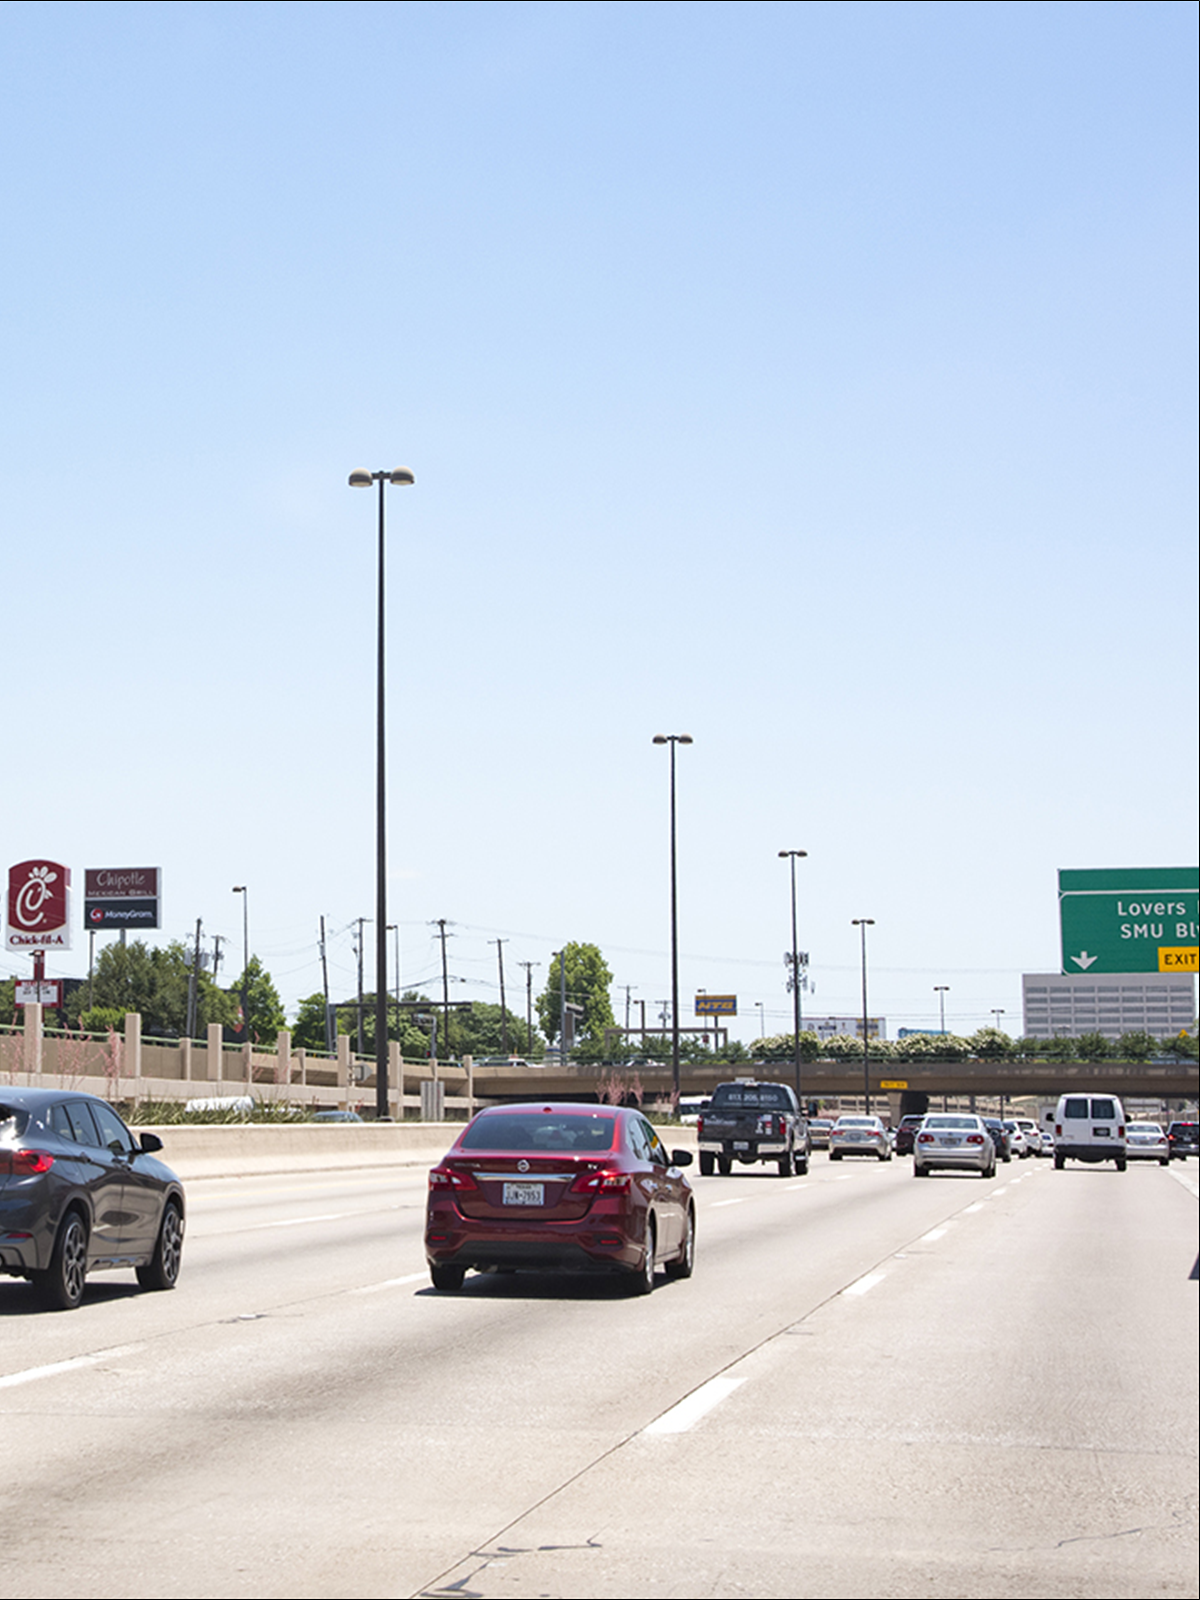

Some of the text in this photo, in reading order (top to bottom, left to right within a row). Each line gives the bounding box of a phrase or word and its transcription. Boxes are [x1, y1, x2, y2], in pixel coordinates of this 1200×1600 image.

[96, 870, 146, 889] Chipotle
[104, 910, 153, 920] MoneyGram
[1117, 901, 1186, 917] Lovers
[1120, 922, 1199, 939] SMU Bl
[9, 934, 64, 946] Chick-fil-A
[1164, 953, 1197, 966] EXIT
